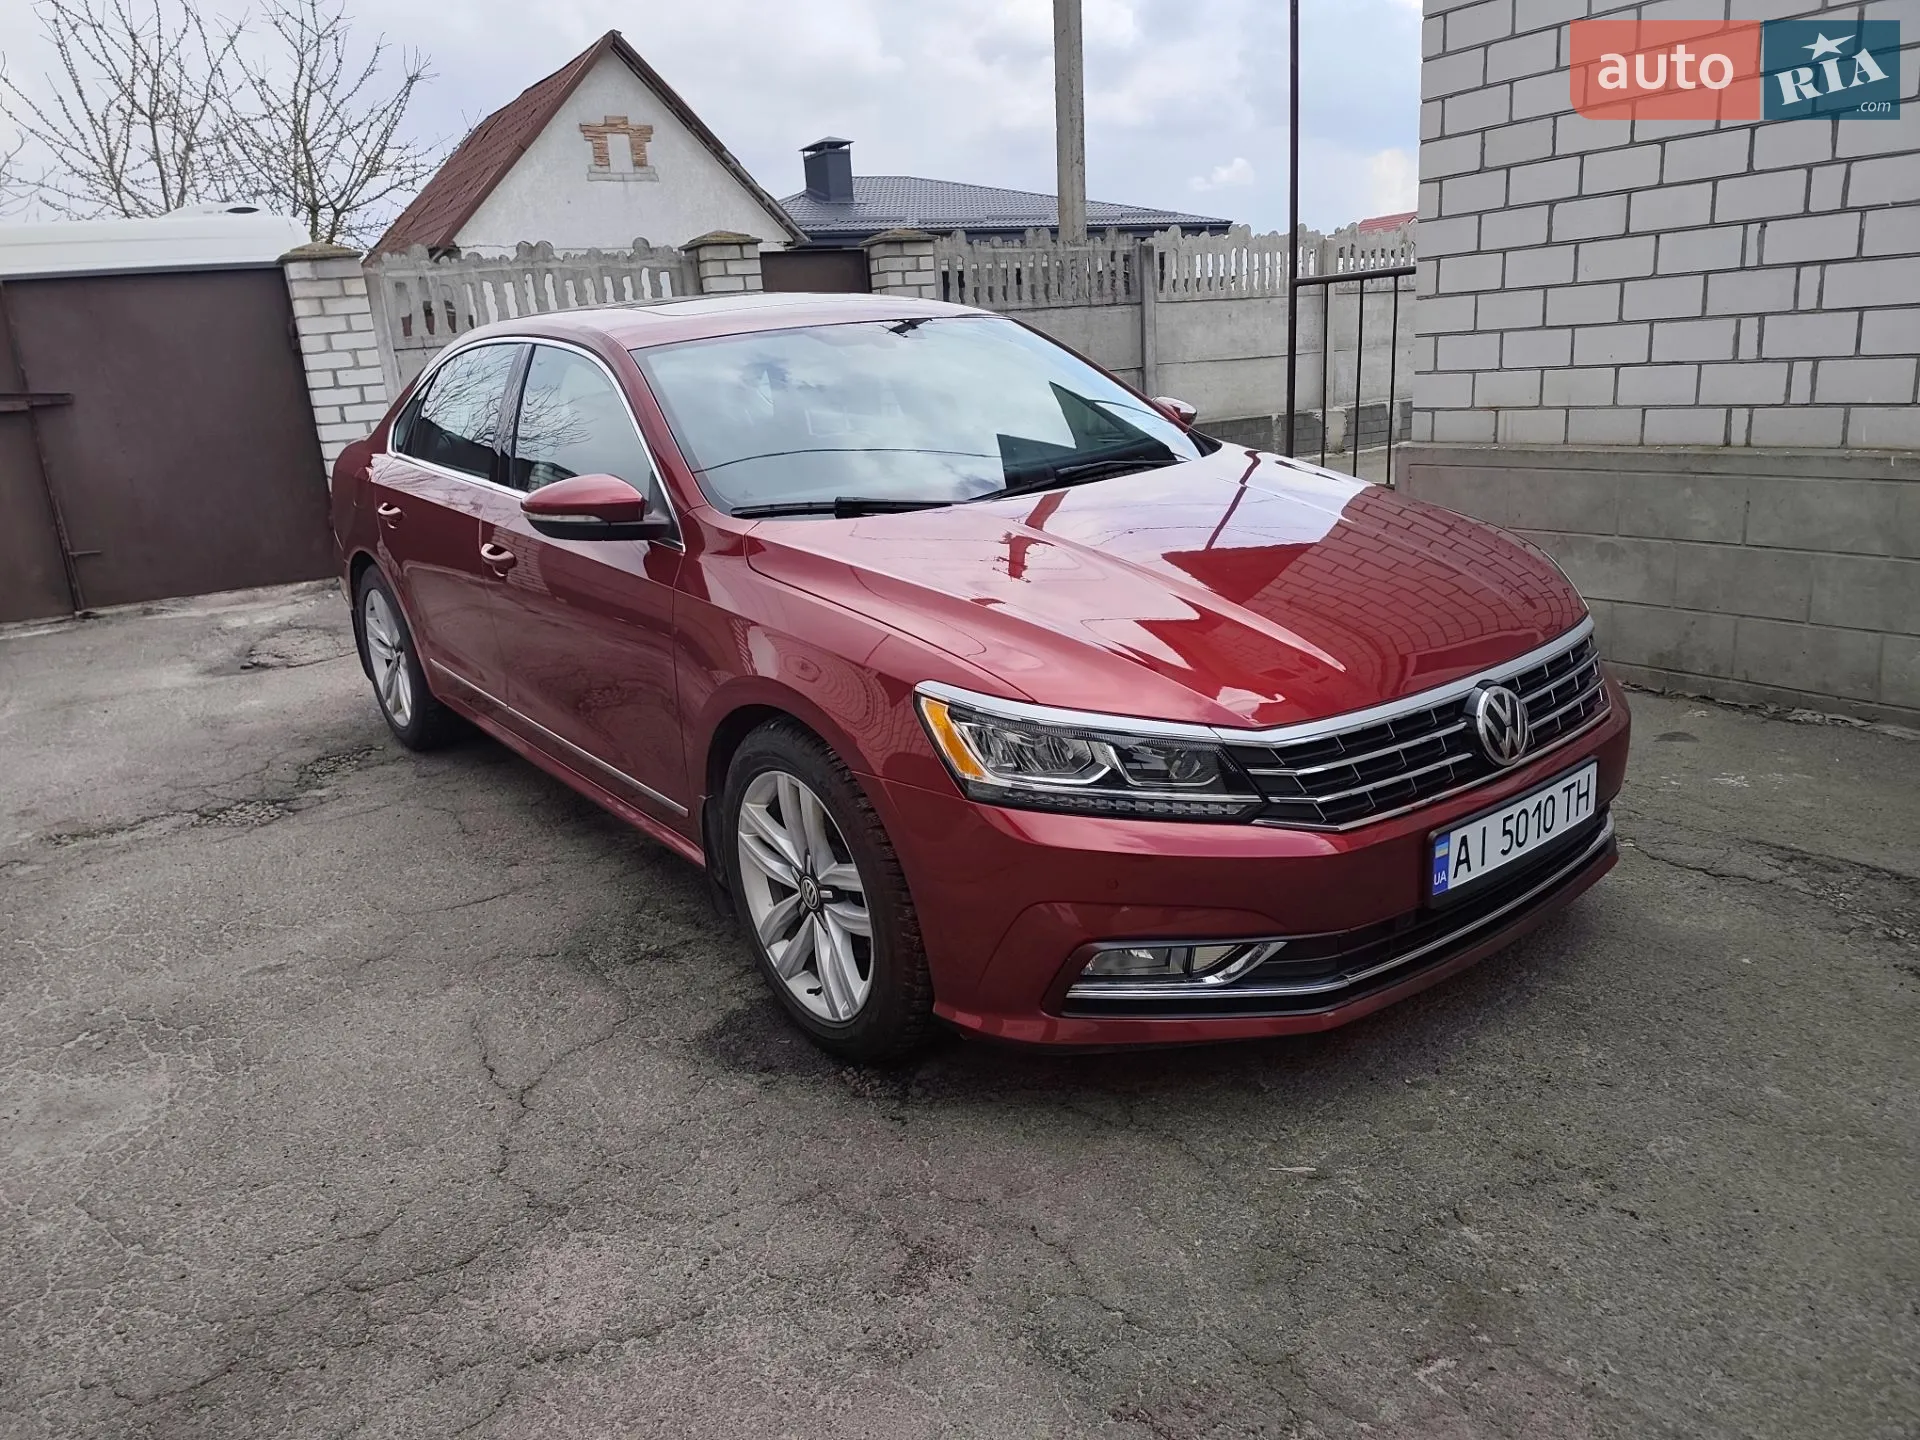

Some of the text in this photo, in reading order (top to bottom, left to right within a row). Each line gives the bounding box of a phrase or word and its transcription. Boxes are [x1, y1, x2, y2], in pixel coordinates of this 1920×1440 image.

[1453, 773, 1591, 879] AI 5010 TH
[1433, 870, 1447, 886] UA
